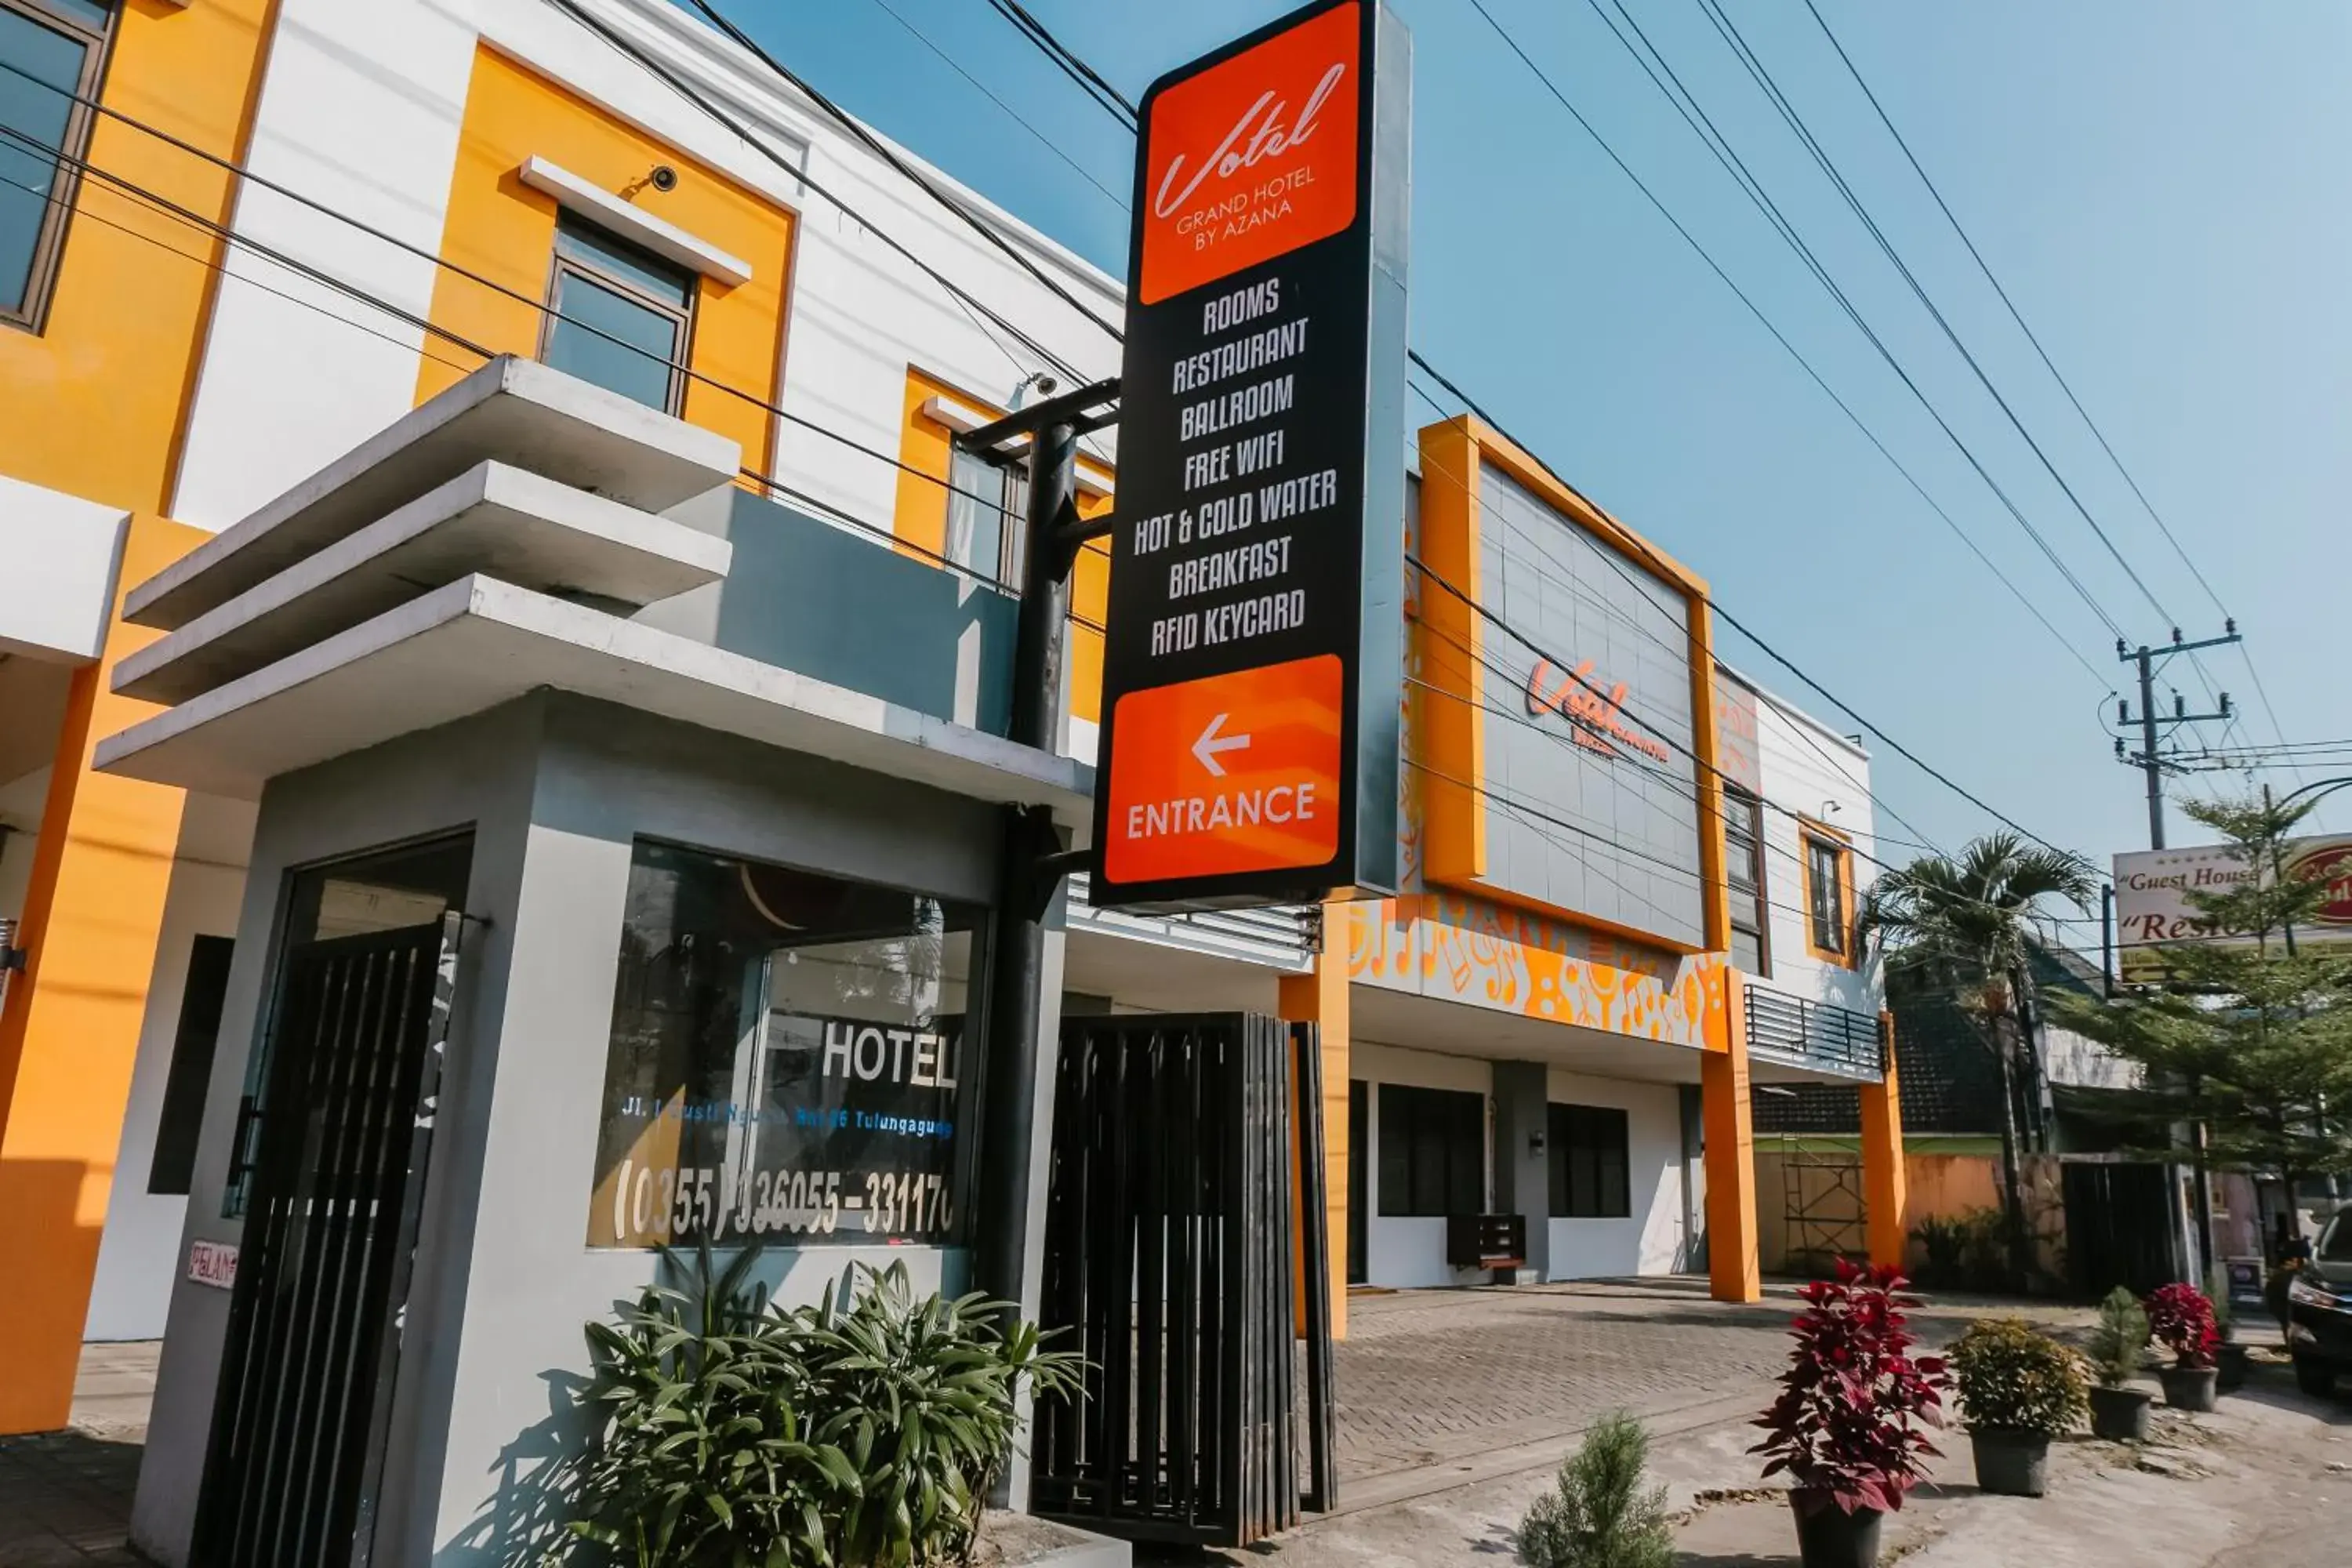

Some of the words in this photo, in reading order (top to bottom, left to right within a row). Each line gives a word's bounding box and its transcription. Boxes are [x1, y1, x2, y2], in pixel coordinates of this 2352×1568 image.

[1155, 63, 1345, 218] Votel
[1176, 193, 1247, 234] GRAND
[1254, 166, 1315, 199] HOTEL
[1195, 229, 1216, 251] BY
[1222, 201, 1292, 241] AZANA
[1203, 278, 1279, 336] ROOMS
[1173, 318, 1308, 394] RESTAURANT
[1181, 375, 1294, 441] BALLROOM
[1185, 445, 1230, 491] FREE
[1236, 429, 1284, 476] WIFI
[1134, 514, 1173, 556] HOT
[1179, 511, 1192, 543] &
[1199, 493, 1252, 540] COLD
[1260, 469, 1336, 523] WATER
[1169, 536, 1291, 600] BREAKFAST
[1151, 613, 1197, 656] RFID
[1204, 589, 1305, 645] KEYCARD
[1127, 782, 1315, 839] ENTRANCE
[822, 1022, 957, 1089] HOTEL
